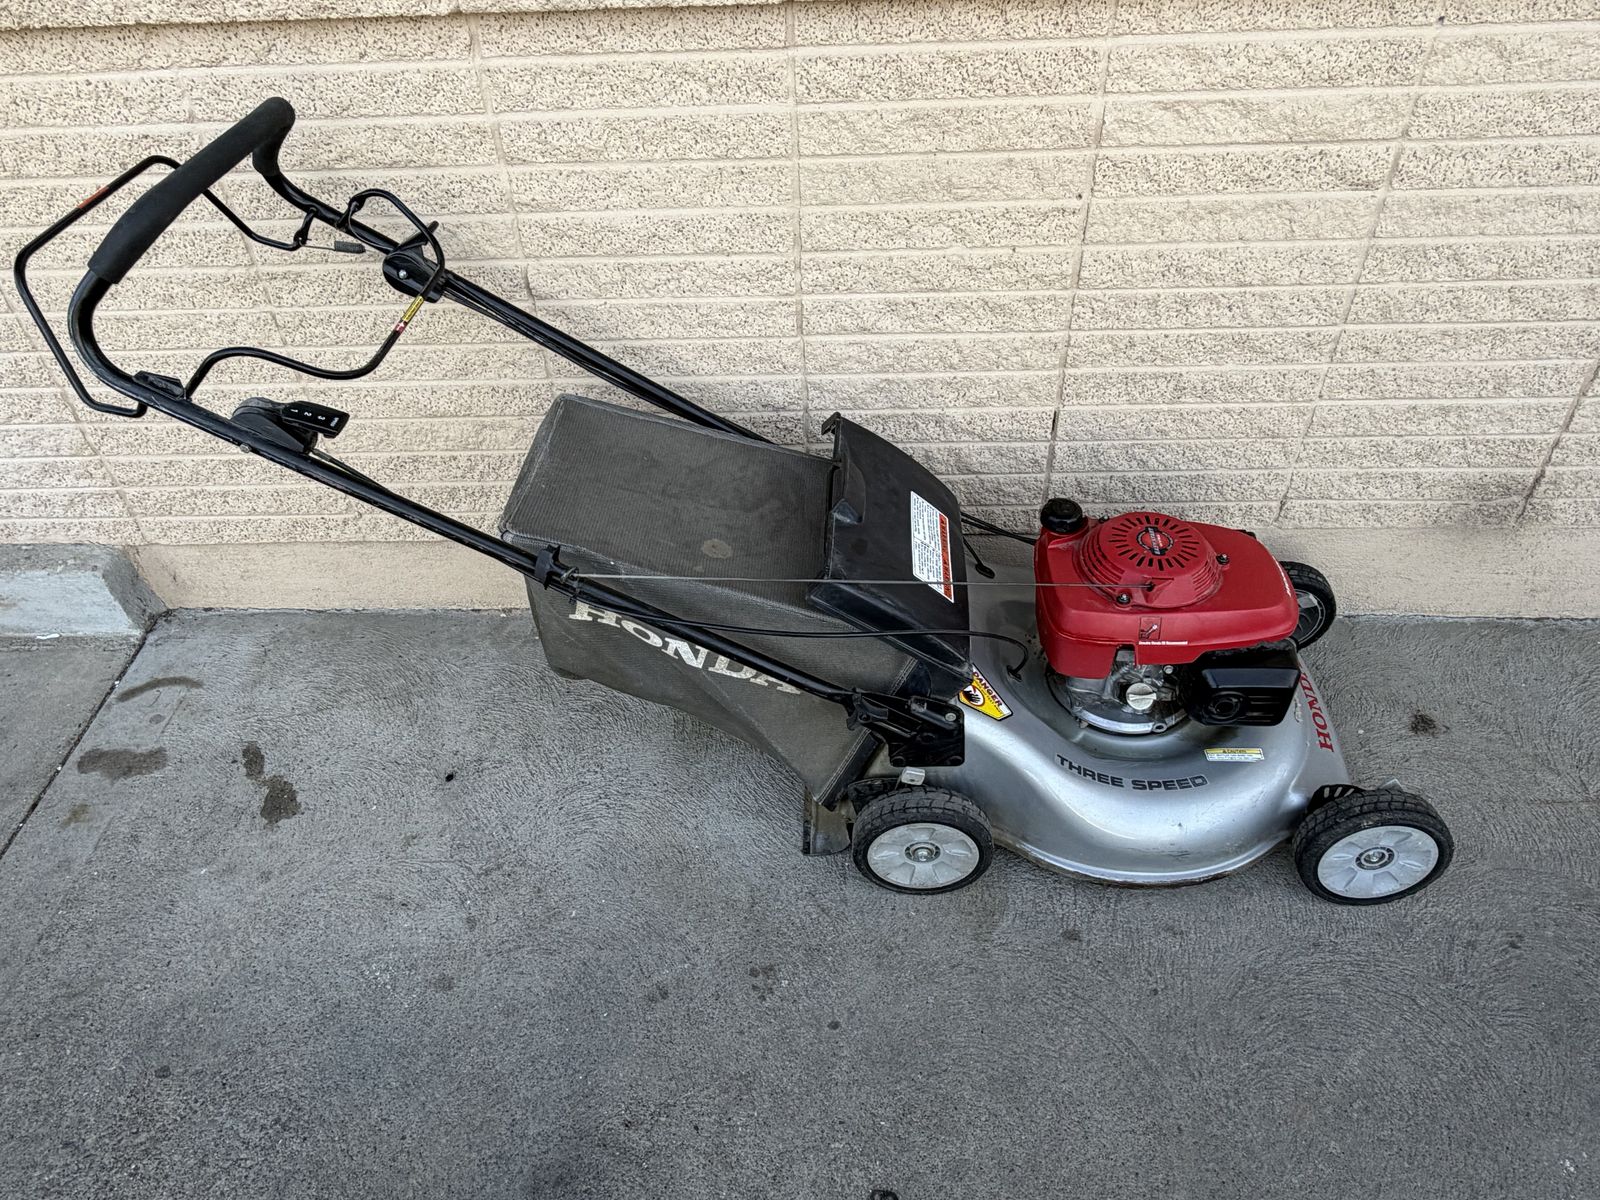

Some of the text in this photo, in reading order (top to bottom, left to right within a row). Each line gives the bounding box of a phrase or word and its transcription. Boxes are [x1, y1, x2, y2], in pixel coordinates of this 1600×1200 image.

[972, 671, 1003, 707] DANGER
[1299, 667, 1335, 753] HOND
[1057, 754, 1208, 791] THREE SPEED
